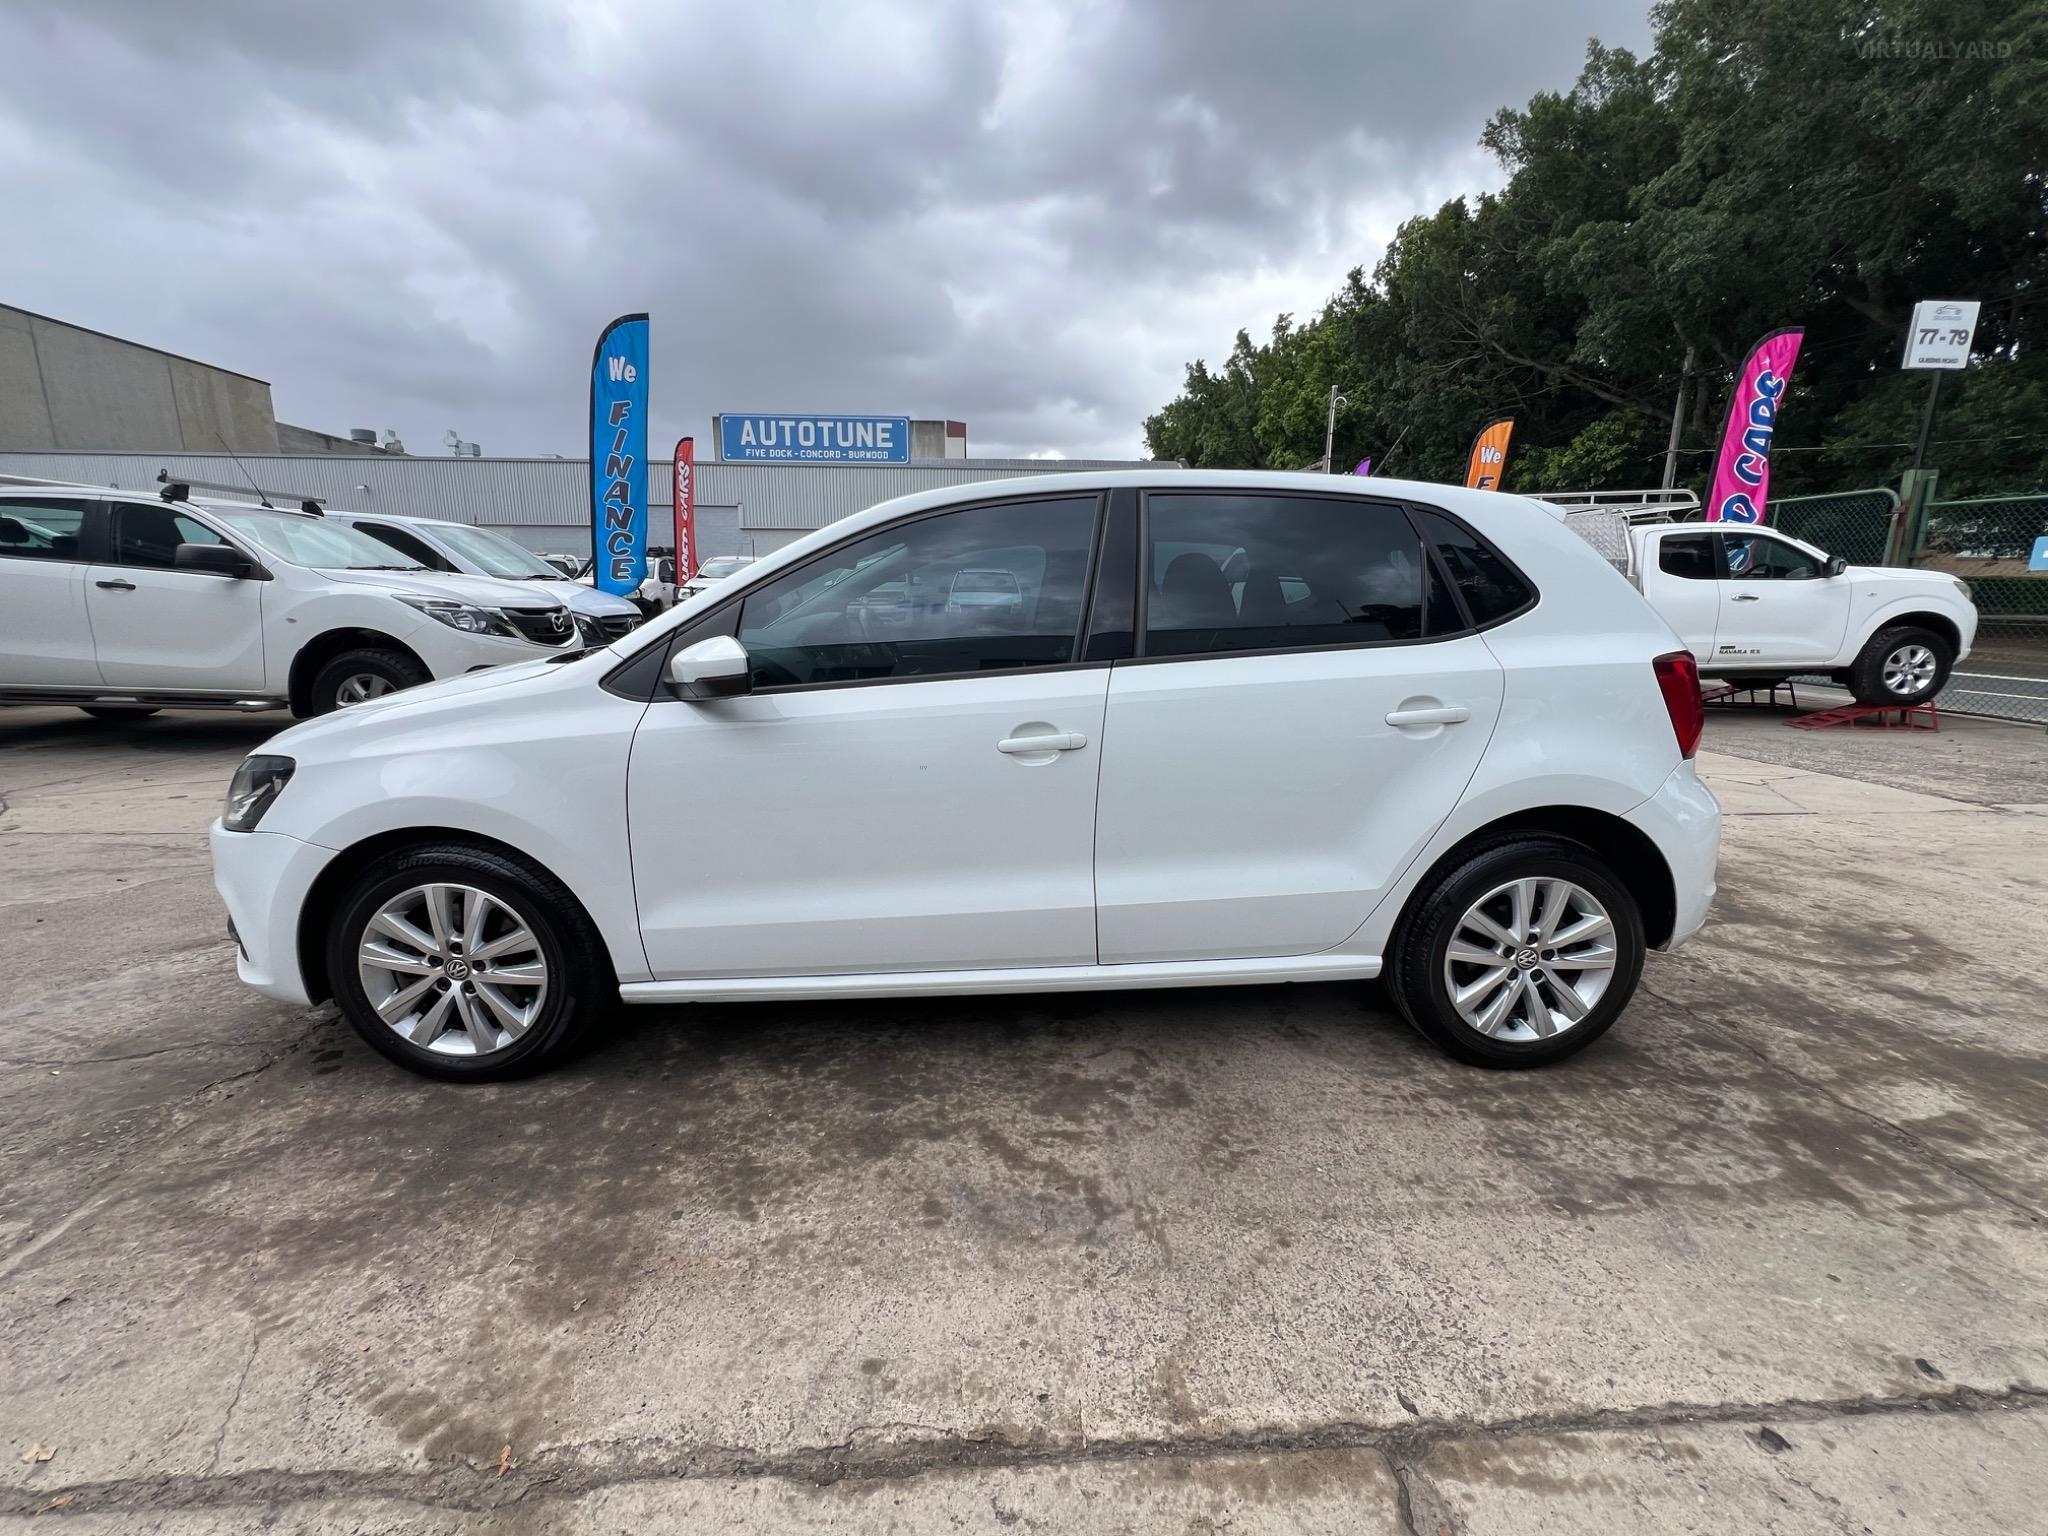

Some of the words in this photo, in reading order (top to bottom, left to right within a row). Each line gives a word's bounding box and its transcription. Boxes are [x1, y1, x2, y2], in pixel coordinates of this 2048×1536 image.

[1918, 328, 1939, 345] 77
[1949, 329, 1970, 346] 79
[607, 355, 637, 383] We
[740, 420, 893, 448] AUTOTUNE
[745, 448, 767, 458] FIVE
[1480, 446, 1502, 465] We
[603, 400, 636, 582] FINANCE
